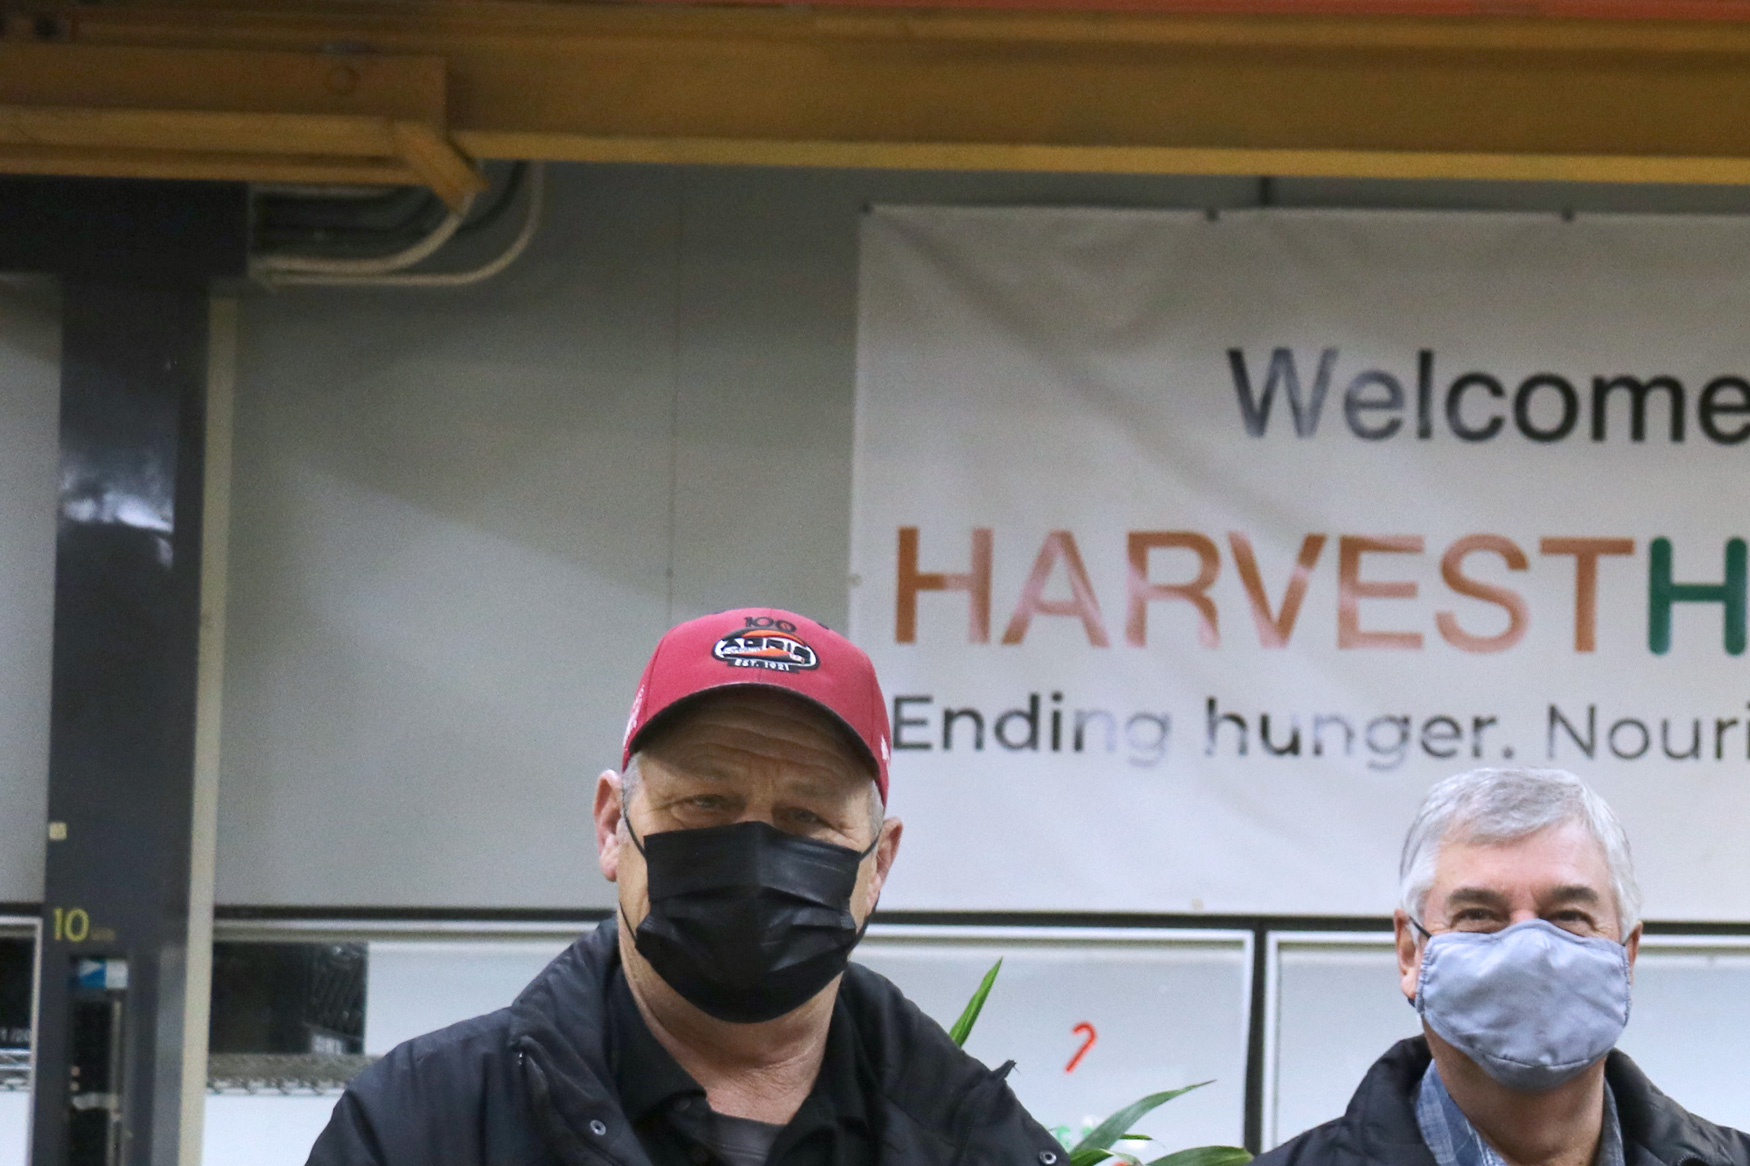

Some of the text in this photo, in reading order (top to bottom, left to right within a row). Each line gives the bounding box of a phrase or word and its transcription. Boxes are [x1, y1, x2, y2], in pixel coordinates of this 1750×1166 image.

[744, 616, 797, 633] 100
[734, 659, 759, 668] EST.
[892, 692, 1172, 769] Ending
[1205, 697, 1516, 771] hunger.
[54, 908, 89, 942] 10
